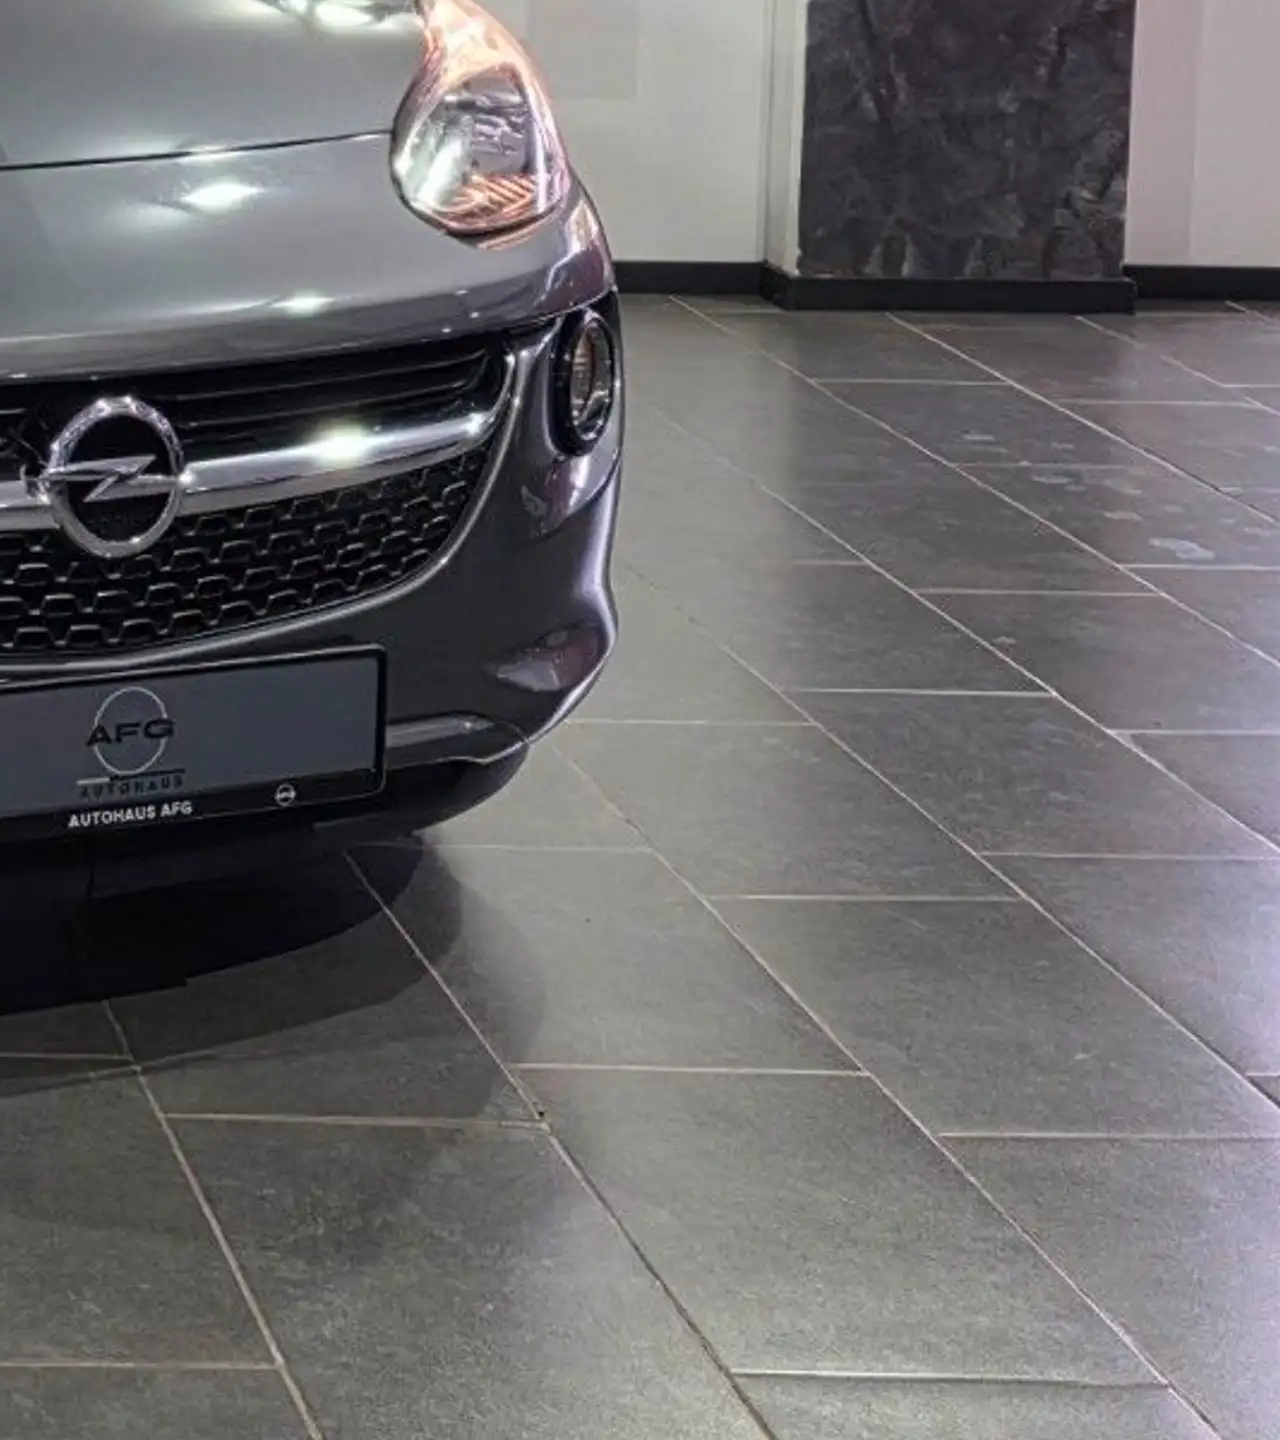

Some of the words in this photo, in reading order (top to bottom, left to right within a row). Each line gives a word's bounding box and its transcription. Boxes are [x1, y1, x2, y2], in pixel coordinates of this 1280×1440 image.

[86, 719, 175, 746] AFG
[80, 775, 183, 798] AUTOHAUS
[68, 805, 156, 828] AUTOHAUS
[160, 800, 192, 817] AFG
